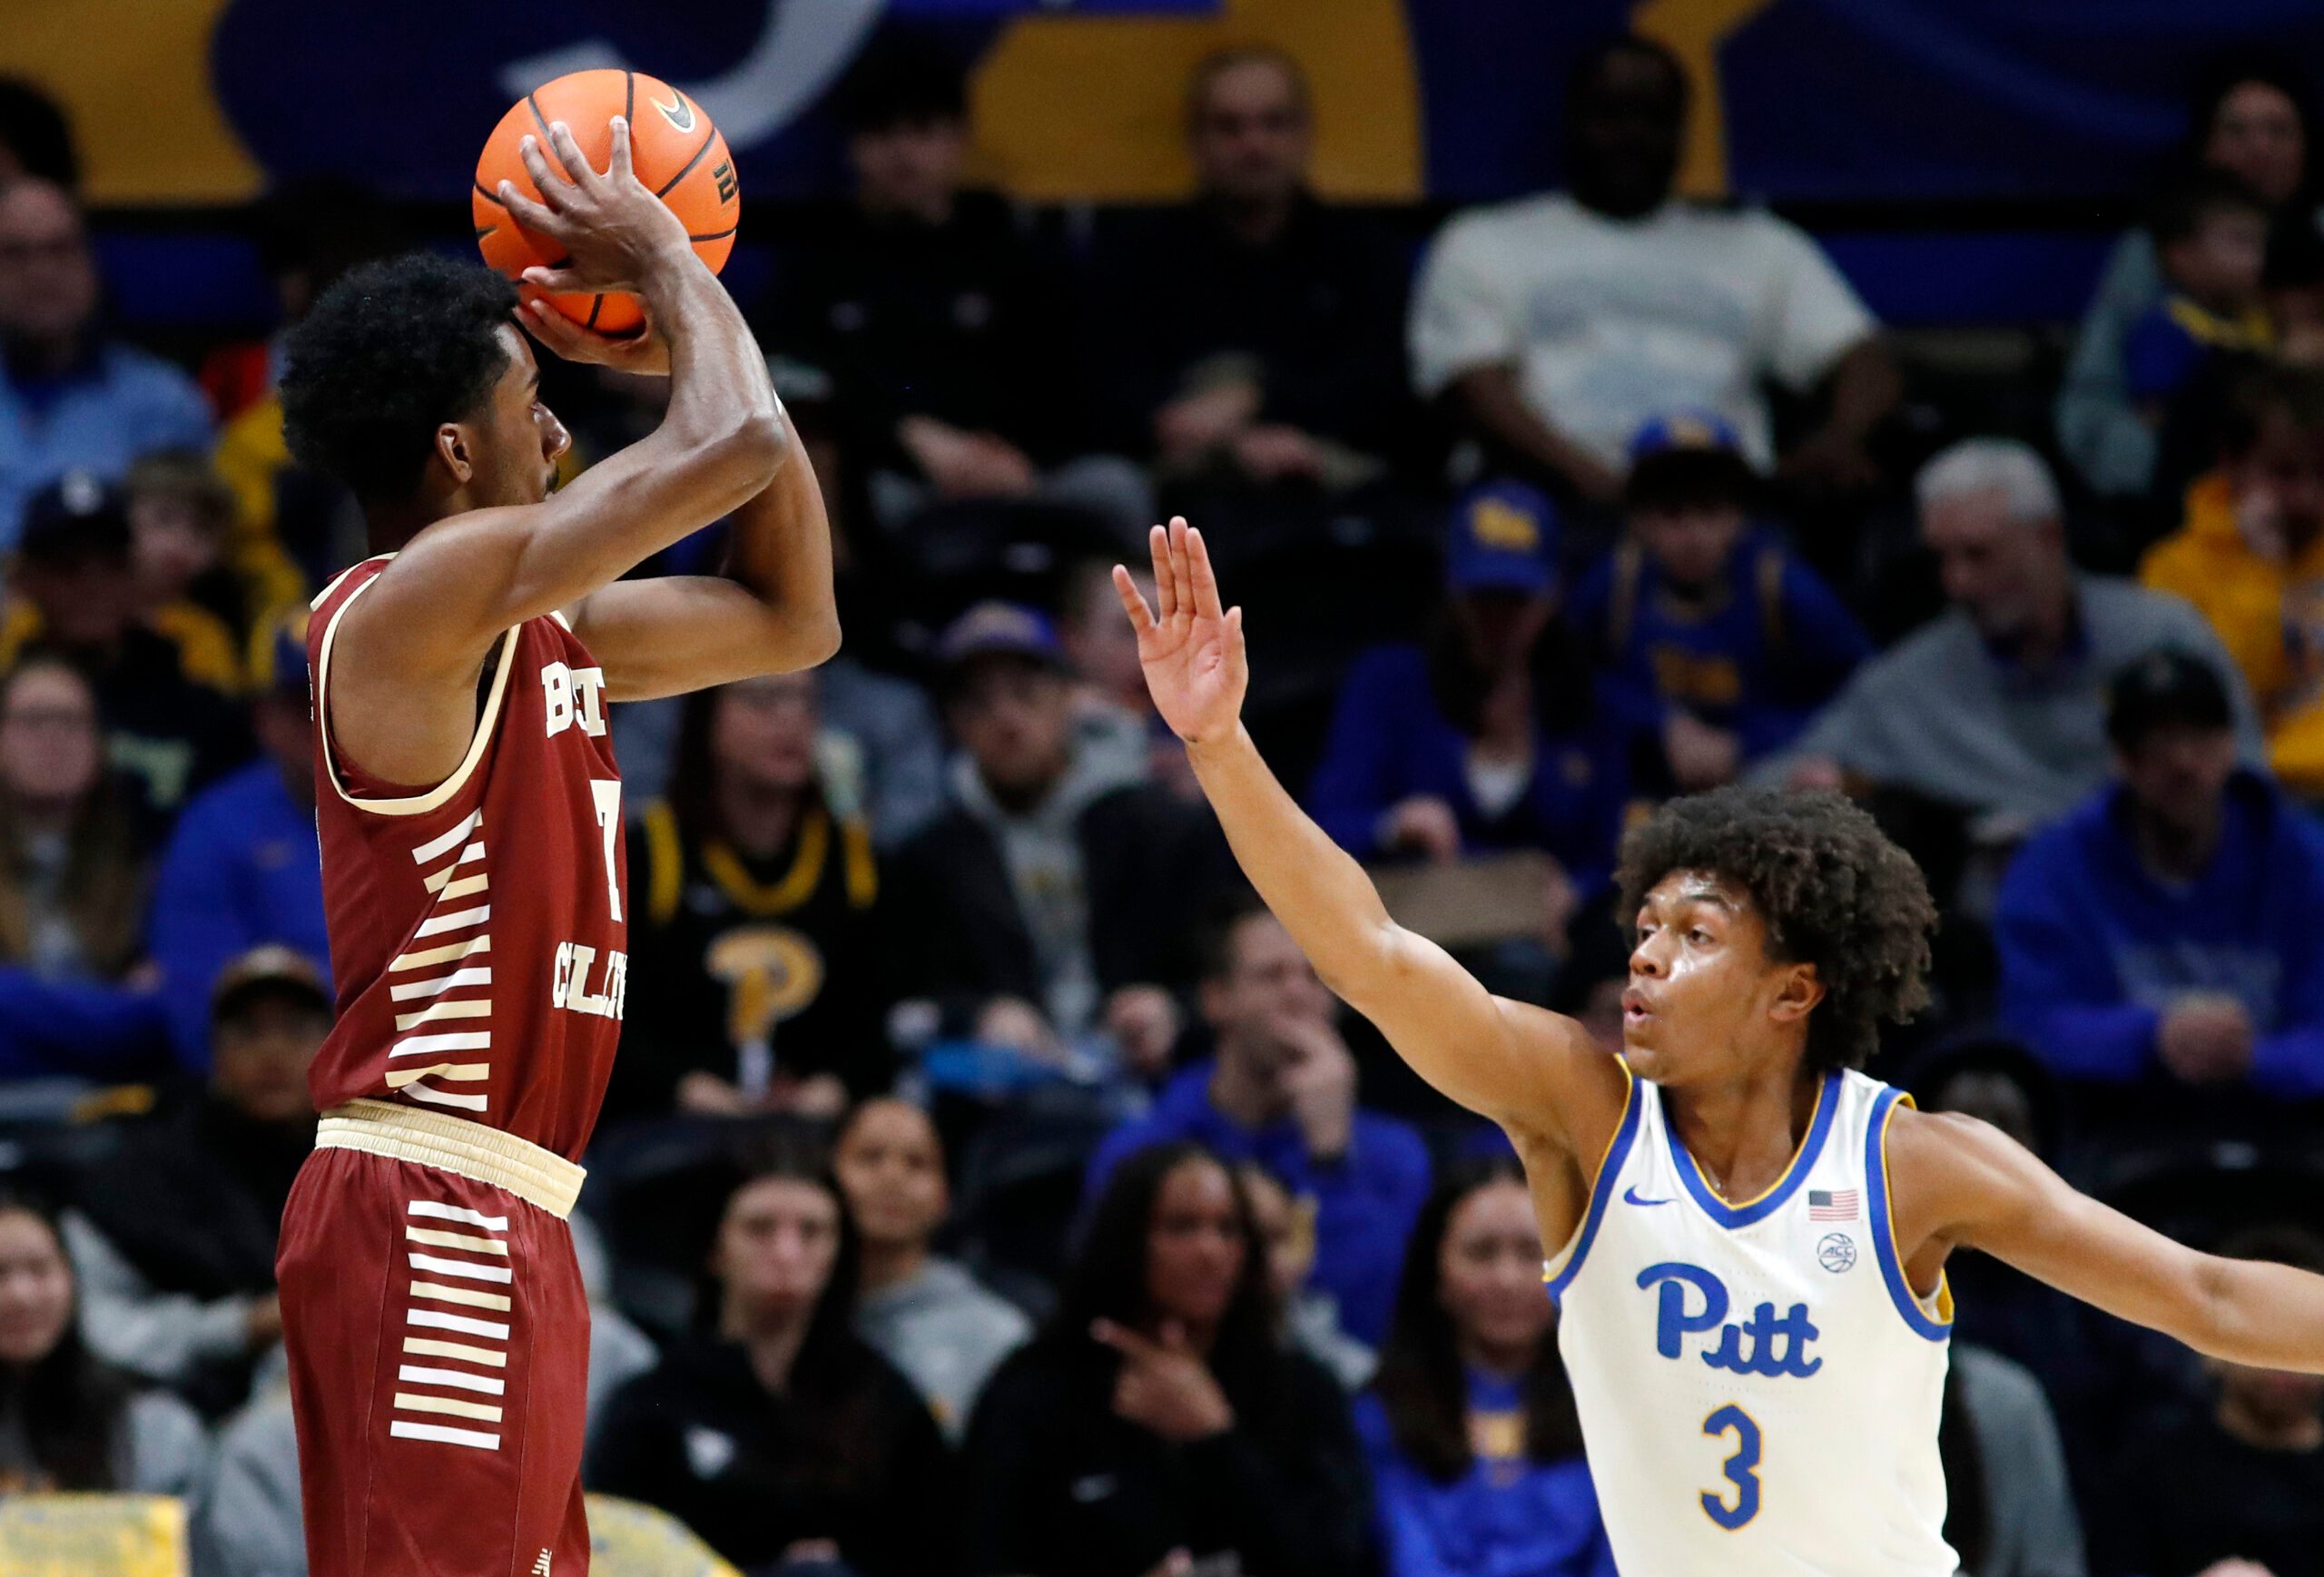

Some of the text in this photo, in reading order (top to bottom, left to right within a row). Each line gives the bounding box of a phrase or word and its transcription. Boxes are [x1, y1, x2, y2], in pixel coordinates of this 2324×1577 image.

[590, 779, 623, 923] 7
[1821, 1247, 1853, 1257] ACC
[1636, 1262, 1823, 1378] Pitt
[1699, 1401, 1764, 1533] 3
